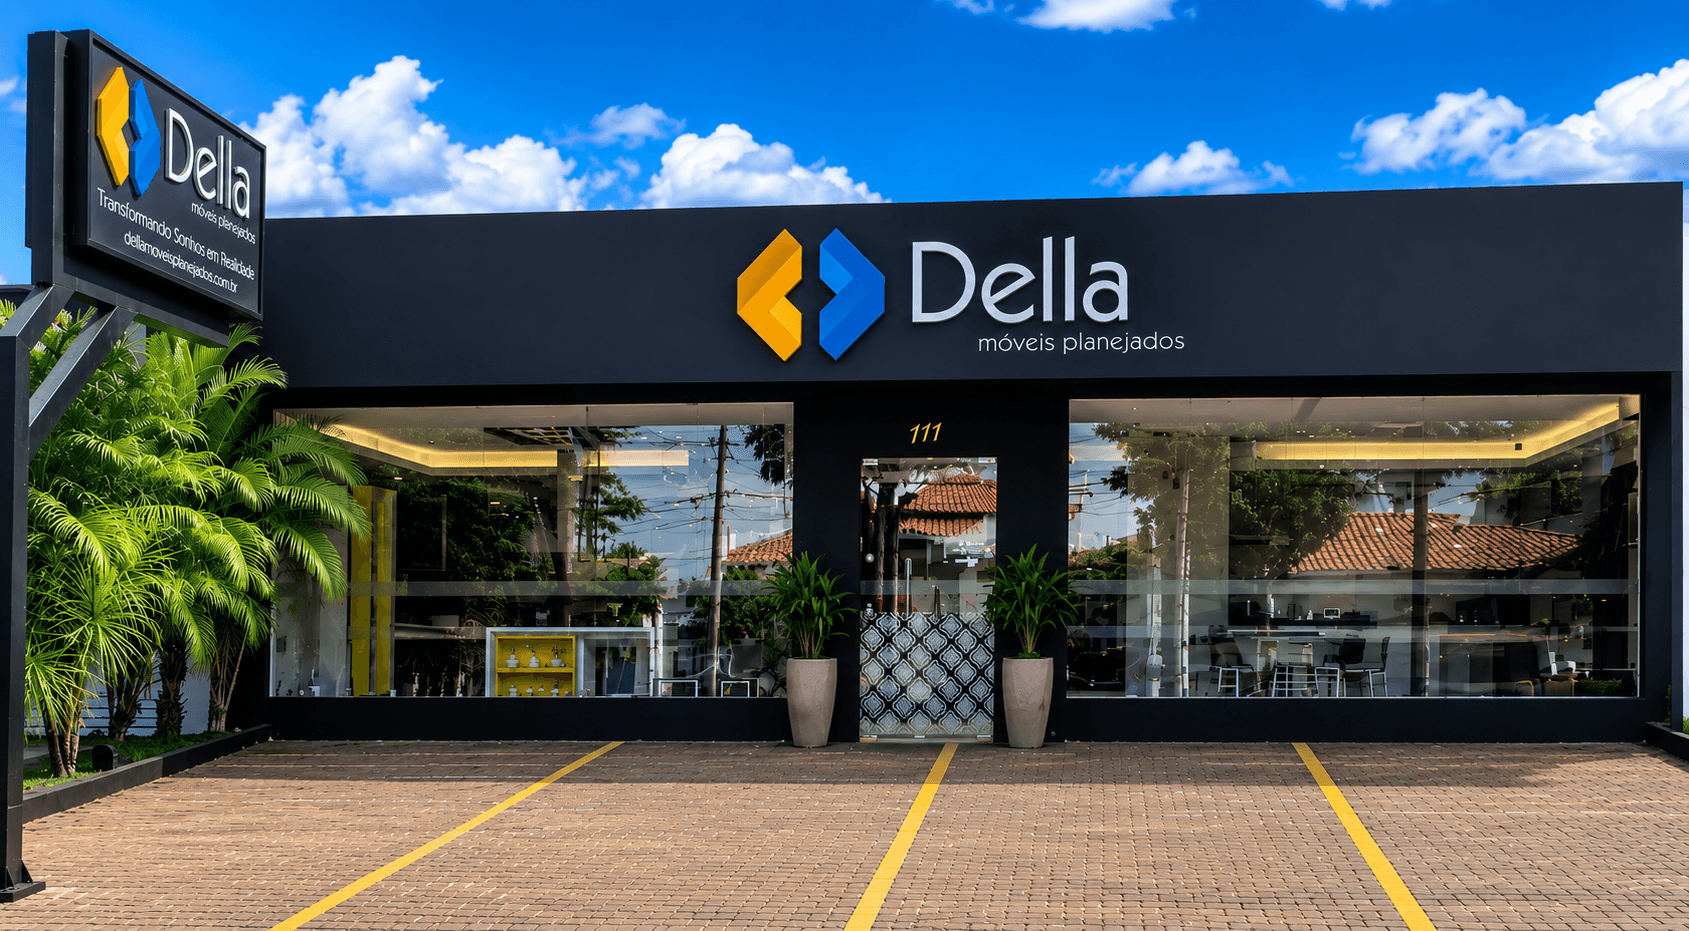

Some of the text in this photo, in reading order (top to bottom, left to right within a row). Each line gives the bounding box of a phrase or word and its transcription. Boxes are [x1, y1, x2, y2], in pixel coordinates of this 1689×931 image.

[165, 108, 249, 219] Della
[97, 187, 255, 281] Transformando Sonhos em Realidade
[191, 202, 256, 244] móveis planejados
[124, 231, 238, 293] dellamoveisplanejados.com.br
[912, 236, 1128, 323] Della
[978, 331, 1185, 354] móveis planejados
[910, 422, 942, 444] 111
